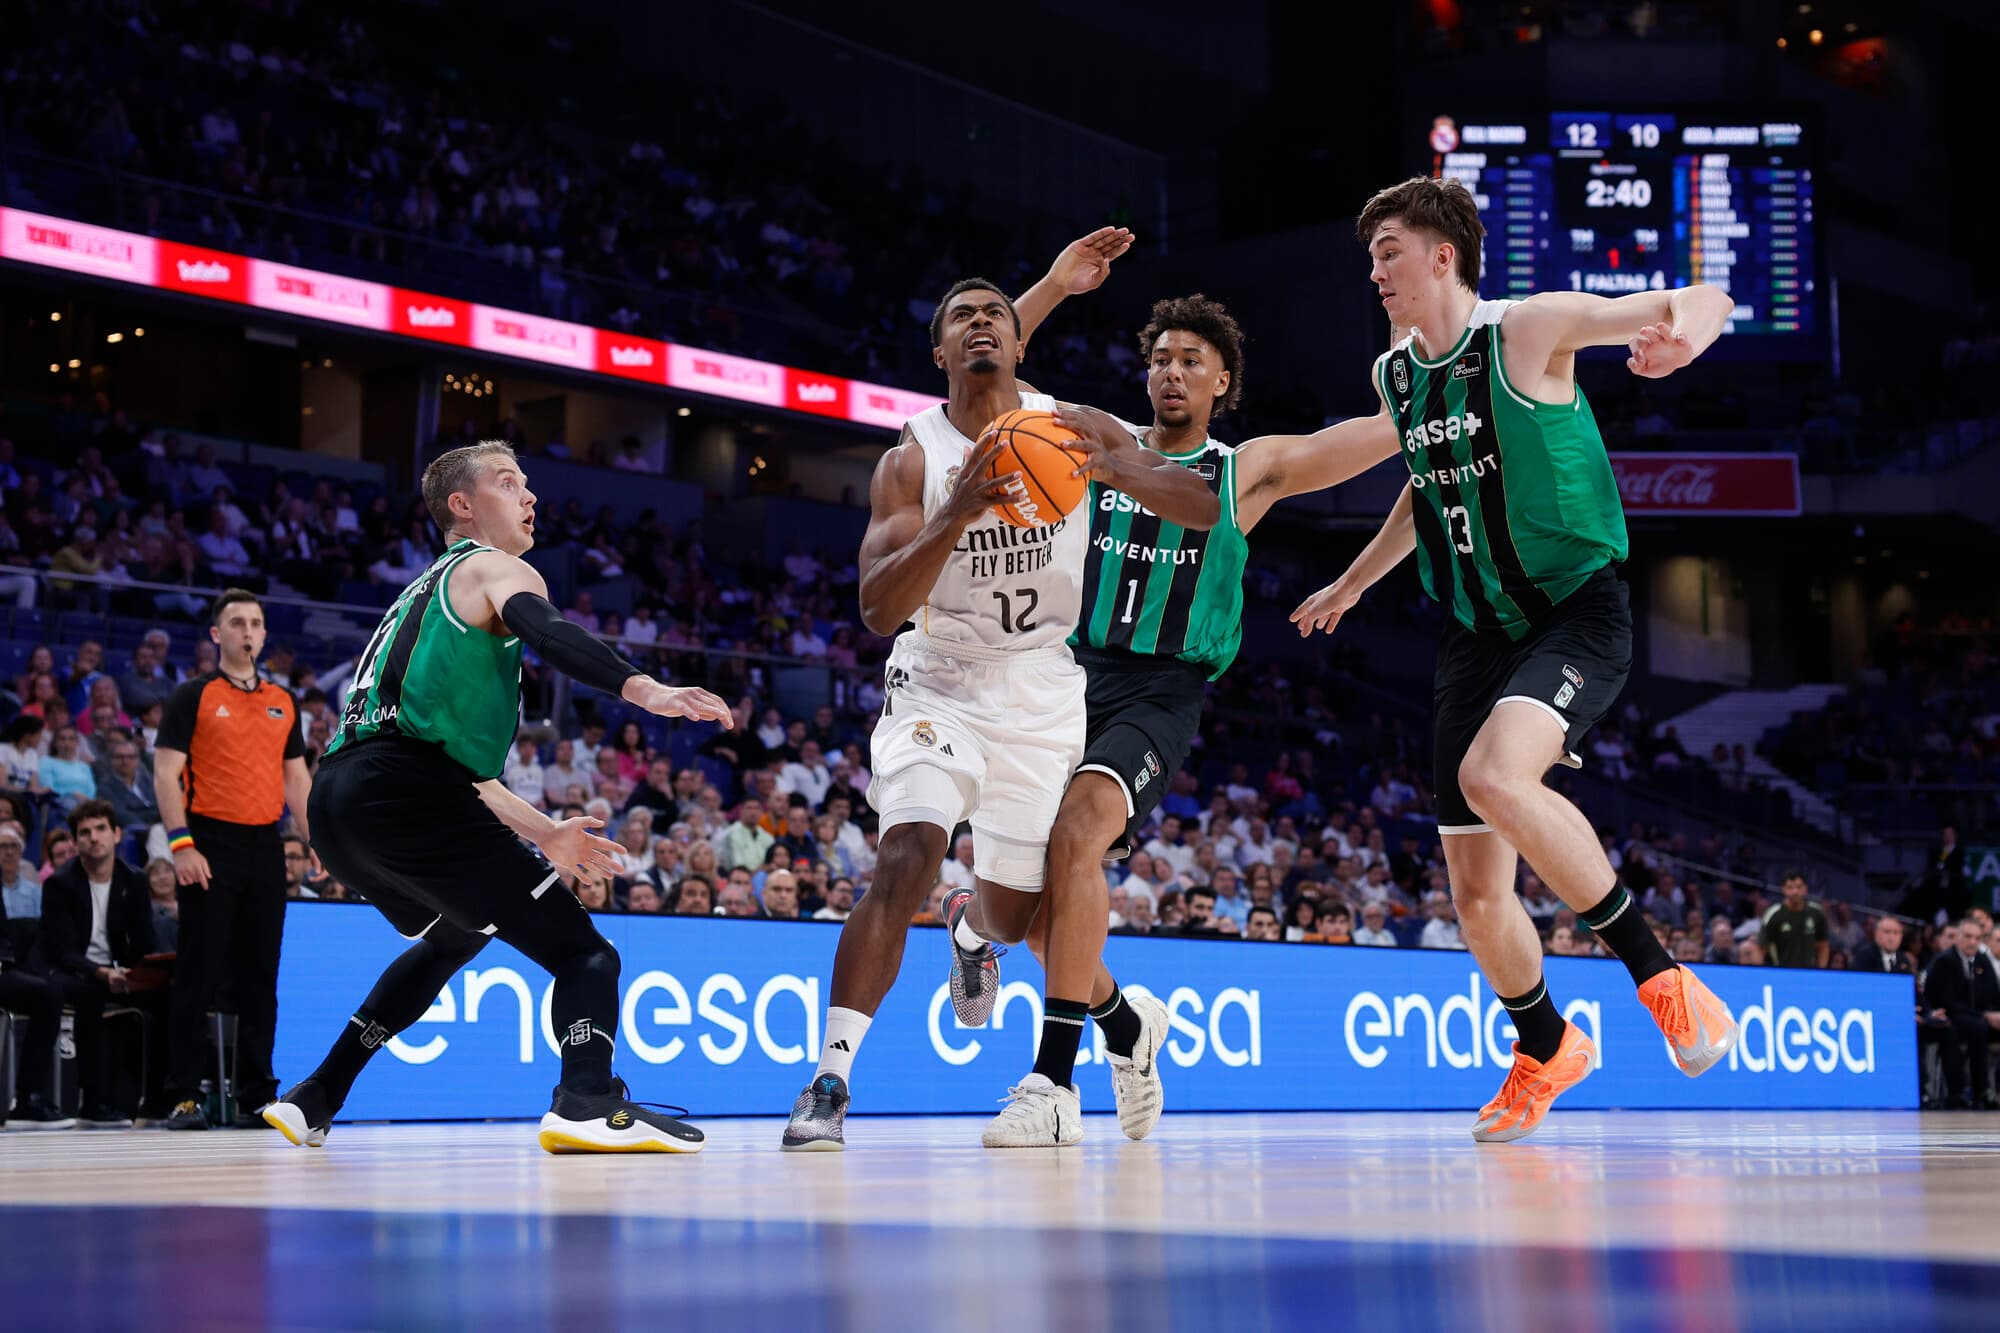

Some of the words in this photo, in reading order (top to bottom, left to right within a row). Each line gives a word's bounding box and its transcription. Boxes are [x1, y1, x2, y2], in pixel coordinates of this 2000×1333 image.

[1566, 122, 1597, 148] 12
[1628, 123, 1660, 148] 10
[1585, 179, 1652, 207] 2:40
[1569, 269, 1581, 291] 1
[1649, 269, 1666, 290] 4
[971, 554, 998, 578] FLY
[1005, 541, 1053, 575] BETTER
[1093, 532, 1199, 565] JOVENTUT
[993, 588, 1039, 634] 12
[1120, 579, 1138, 624] 1
[386, 940, 820, 1064] enesa
[1665, 985, 1875, 1074] desa
